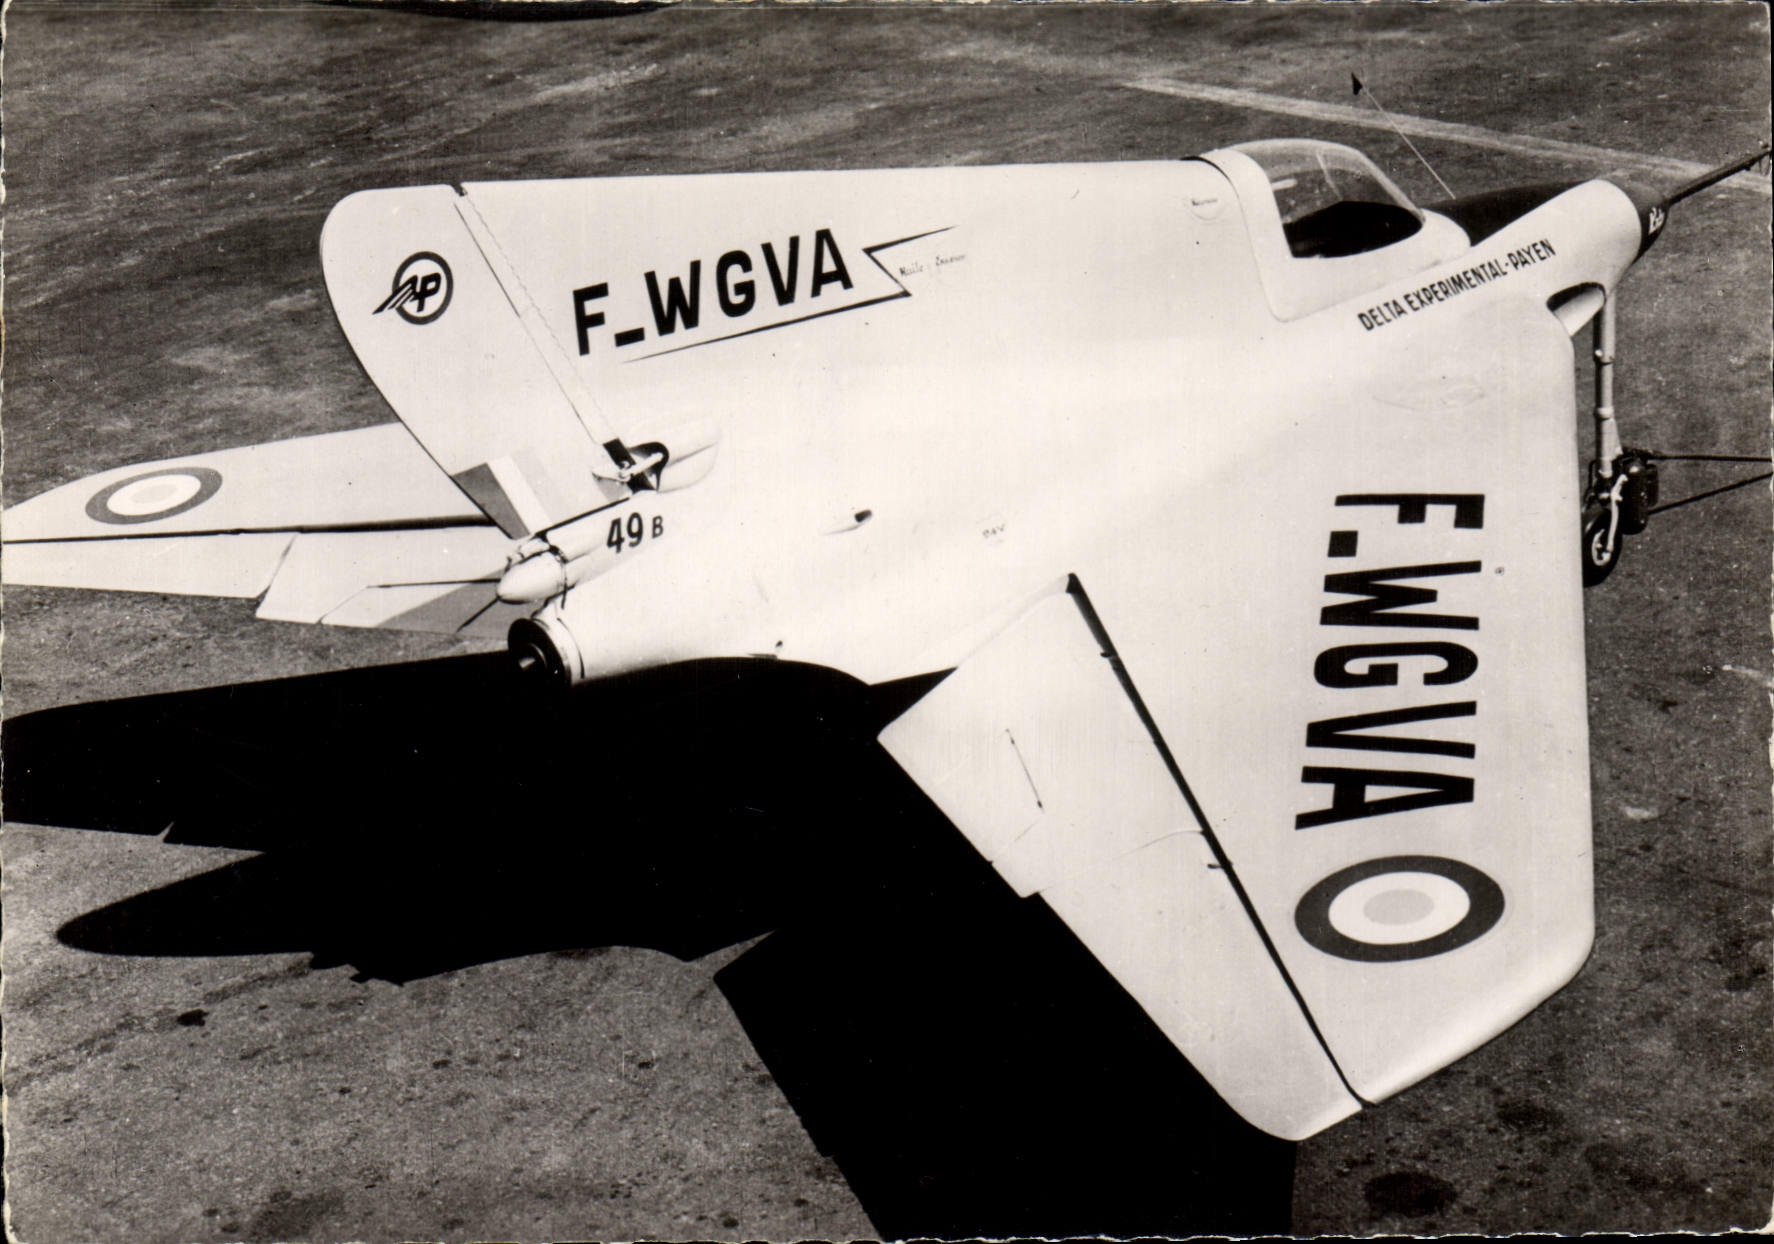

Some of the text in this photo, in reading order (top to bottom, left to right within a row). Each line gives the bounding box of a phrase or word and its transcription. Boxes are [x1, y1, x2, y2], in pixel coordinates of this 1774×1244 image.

[1357, 299, 1407, 331] DELTA
[606, 512, 664, 554] 49 B
